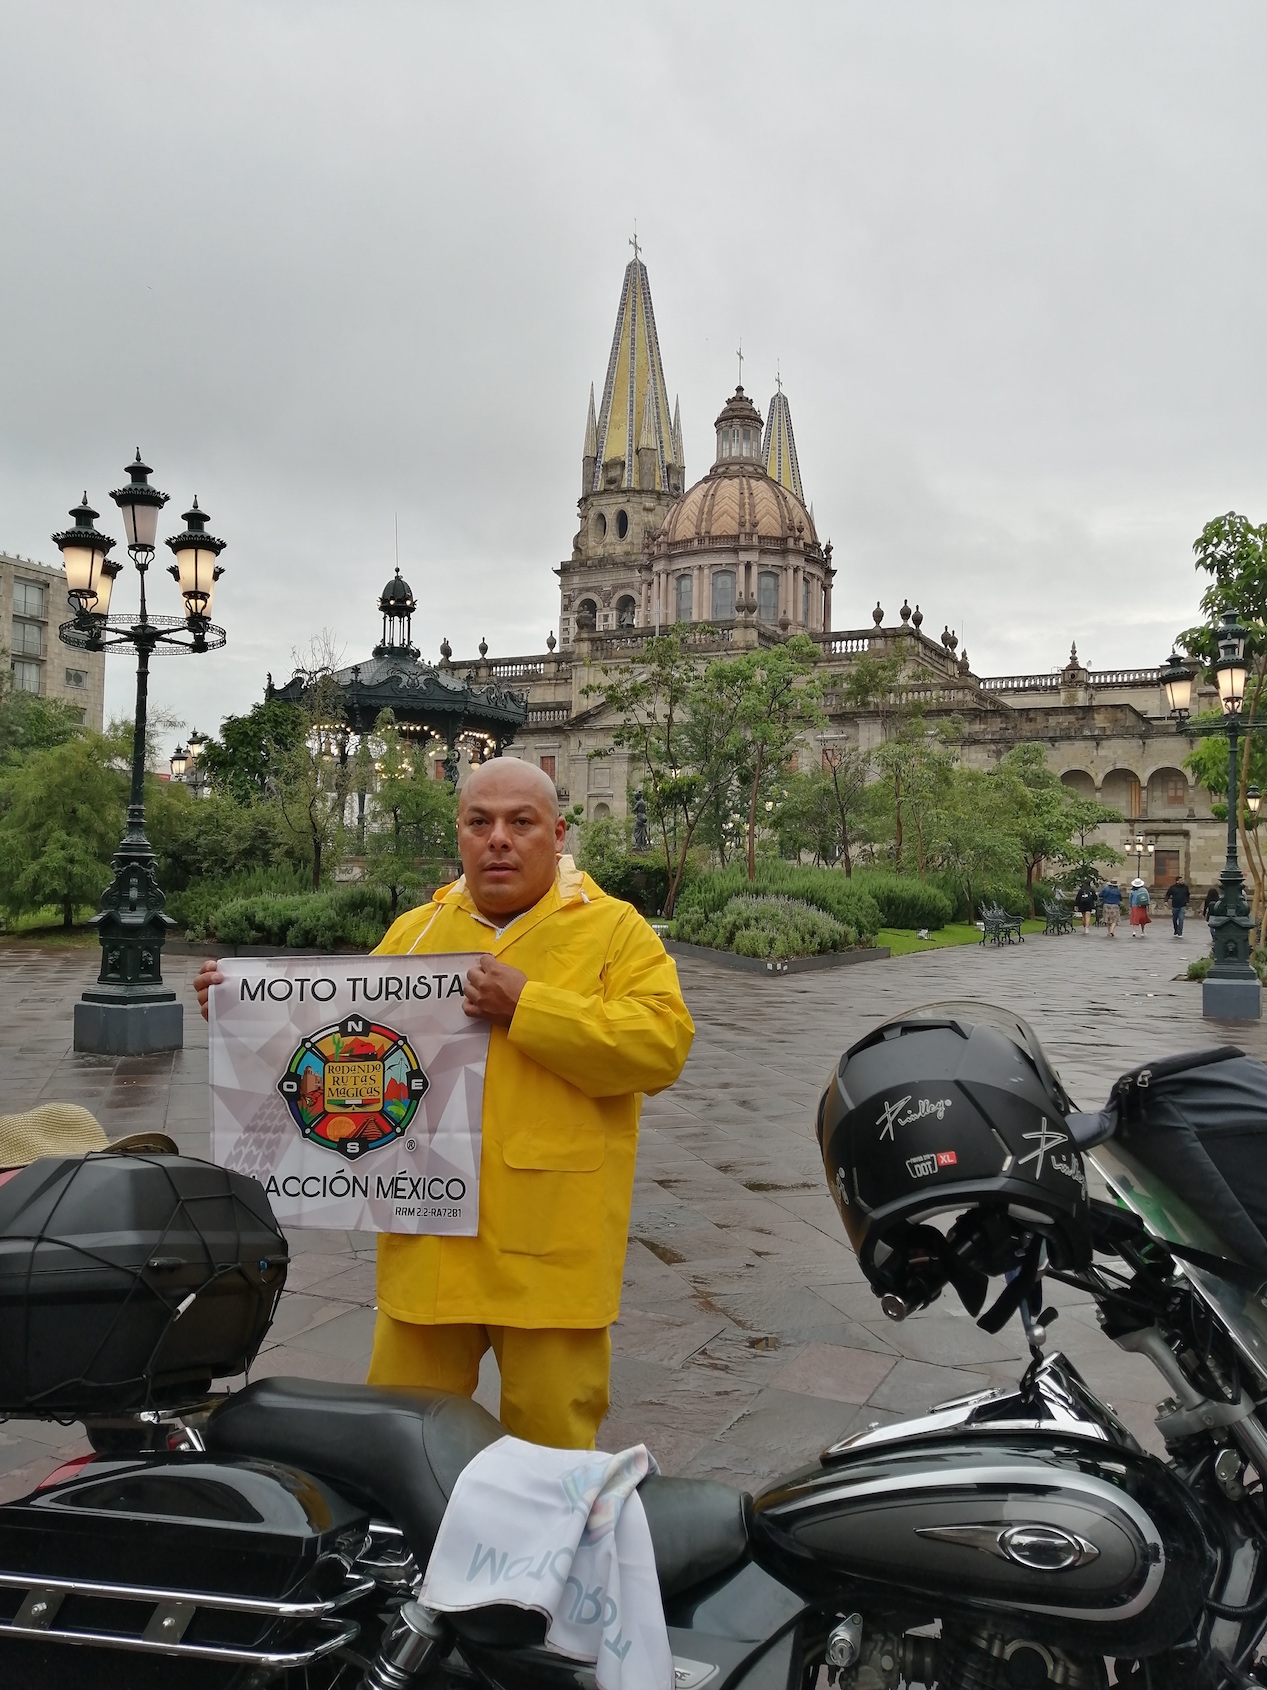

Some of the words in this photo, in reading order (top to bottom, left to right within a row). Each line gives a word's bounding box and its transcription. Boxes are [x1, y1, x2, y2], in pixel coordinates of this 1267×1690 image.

[240, 978, 337, 1002] MOTO
[346, 973, 465, 1002] TURISTA
[347, 1020, 363, 1032] N
[411, 1078, 424, 1090] E
[346, 1142, 360, 1153] S
[939, 1154, 954, 1165] XL
[914, 1161, 933, 1177] DOT
[265, 1168, 369, 1198] ACCIÓN
[376, 1169, 466, 1201] MÉXICO
